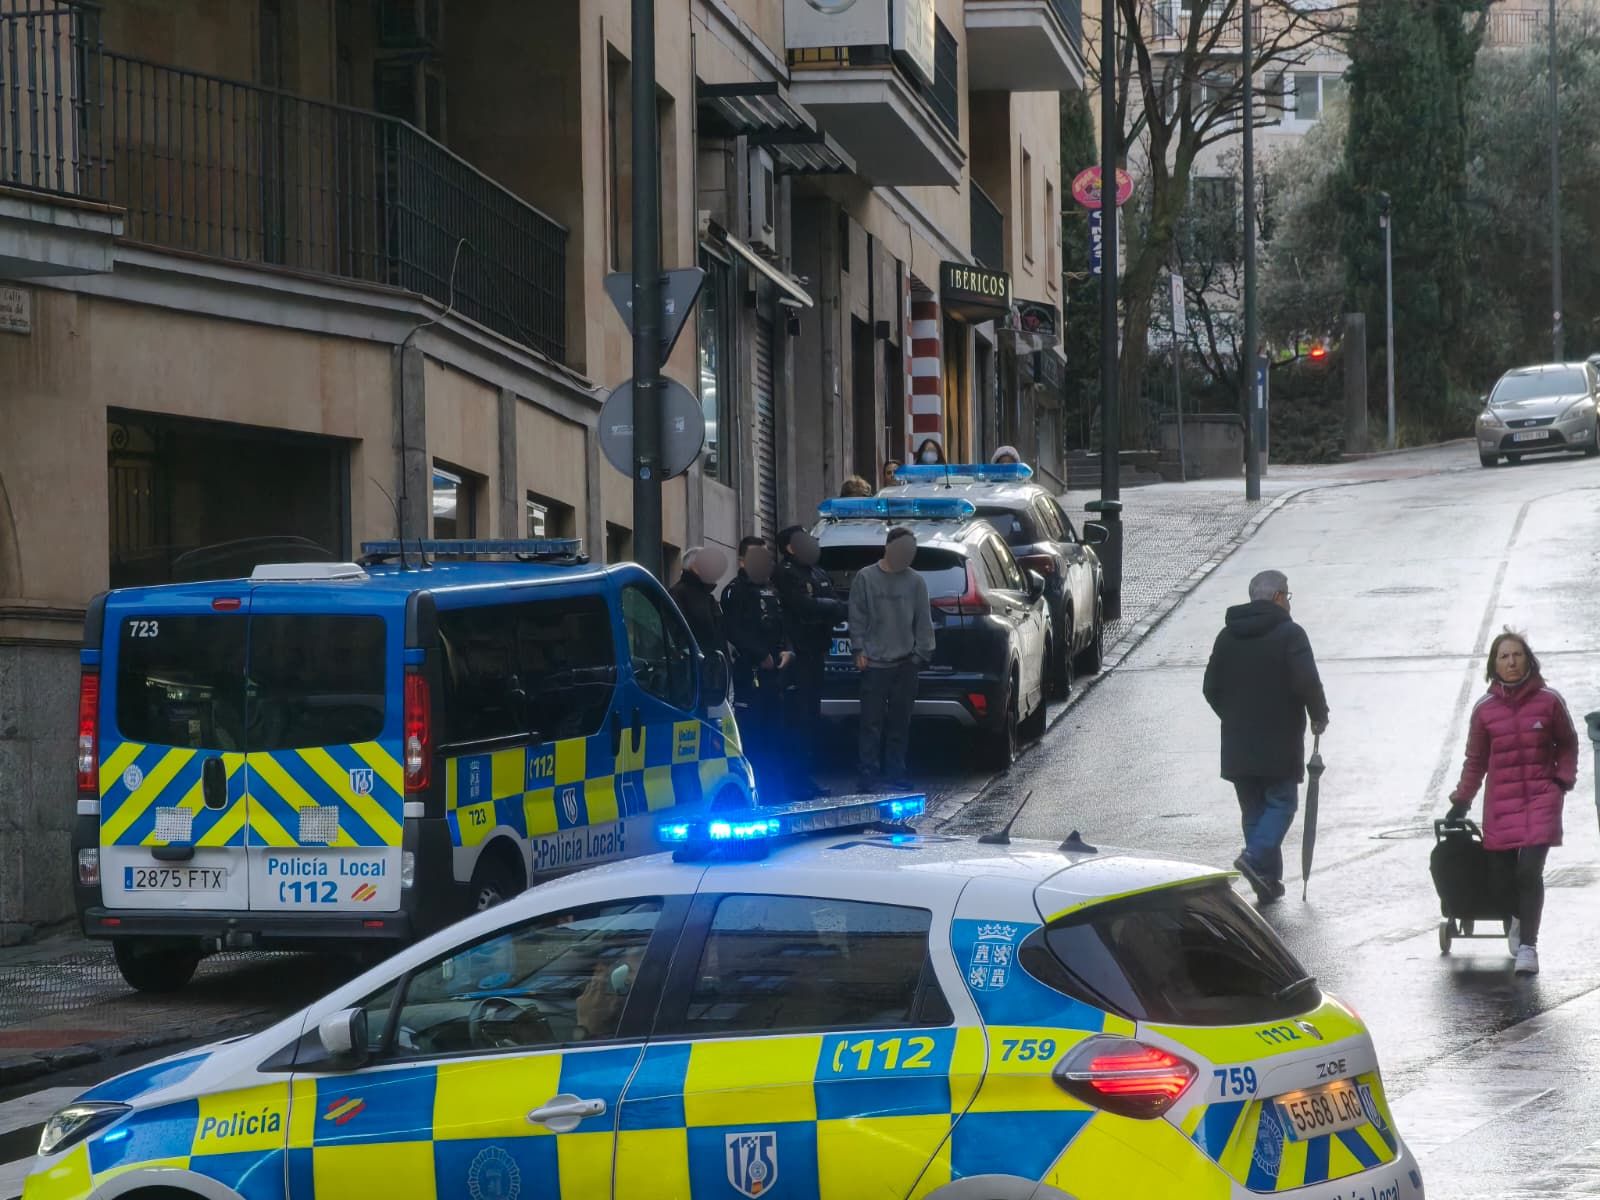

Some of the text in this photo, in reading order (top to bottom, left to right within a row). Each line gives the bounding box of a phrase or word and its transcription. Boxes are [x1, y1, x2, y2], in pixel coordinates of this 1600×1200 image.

[951, 267, 1005, 297] IBÉRICOS
[129, 620, 159, 638] 723
[533, 754, 554, 779] 112
[469, 808, 487, 827] 723
[541, 829, 617, 868] Policía Local
[269, 857, 386, 877] Policía Local
[136, 869, 222, 889] 2875 FTX
[287, 881, 338, 903] 112
[851, 1036, 935, 1071] 112
[1001, 1039, 1056, 1061] 759
[1316, 1059, 1347, 1080] ZOE
[1213, 1066, 1258, 1097] 759
[1290, 1095, 1334, 1132] 5568
[1331, 1088, 1362, 1122] LRC
[200, 1106, 280, 1140] Policía
